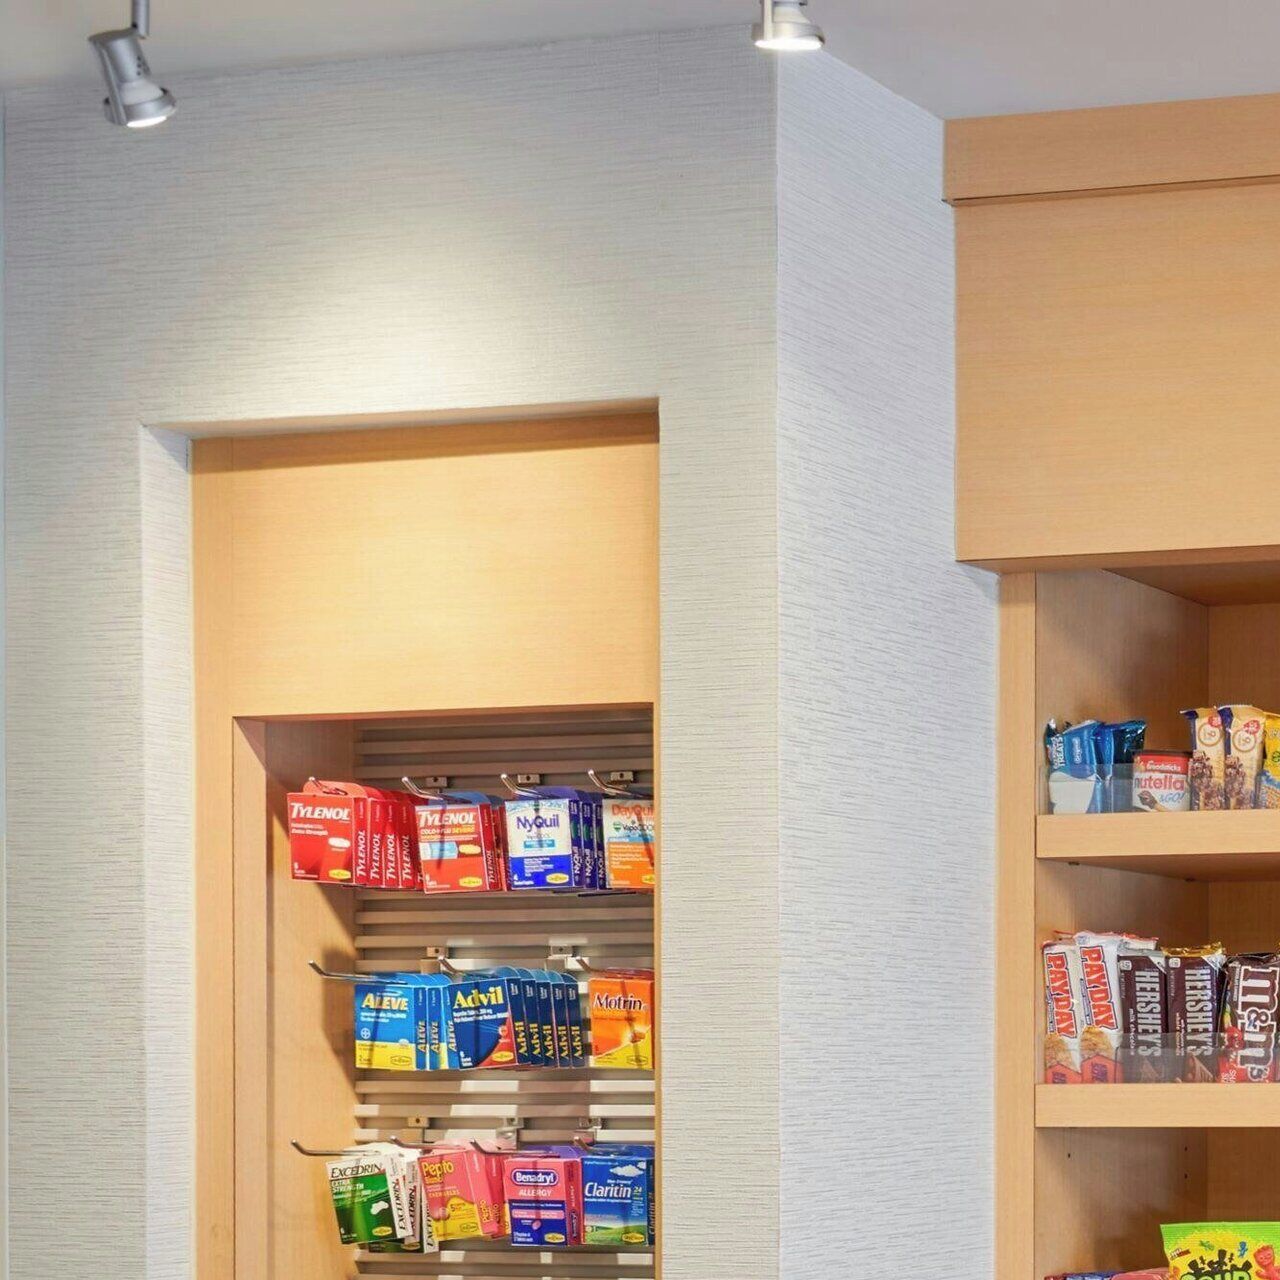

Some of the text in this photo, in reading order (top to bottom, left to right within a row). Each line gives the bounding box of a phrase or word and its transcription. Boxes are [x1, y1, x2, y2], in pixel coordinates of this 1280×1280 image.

[1134, 773, 1184, 790] nutella
[290, 802, 351, 821] TYLENOL
[516, 815, 560, 830] NyQuil
[361, 993, 409, 1010] ALEVE
[454, 985, 504, 1009] Advil
[593, 992, 642, 1012] Motrin
[1047, 953, 1077, 1038] PAYDAY
[330, 1162, 383, 1179] EXCEDRIN
[421, 1161, 454, 1178] Pepto
[514, 1172, 555, 1184] Benadryl
[584, 1182, 631, 1199] Claritin
